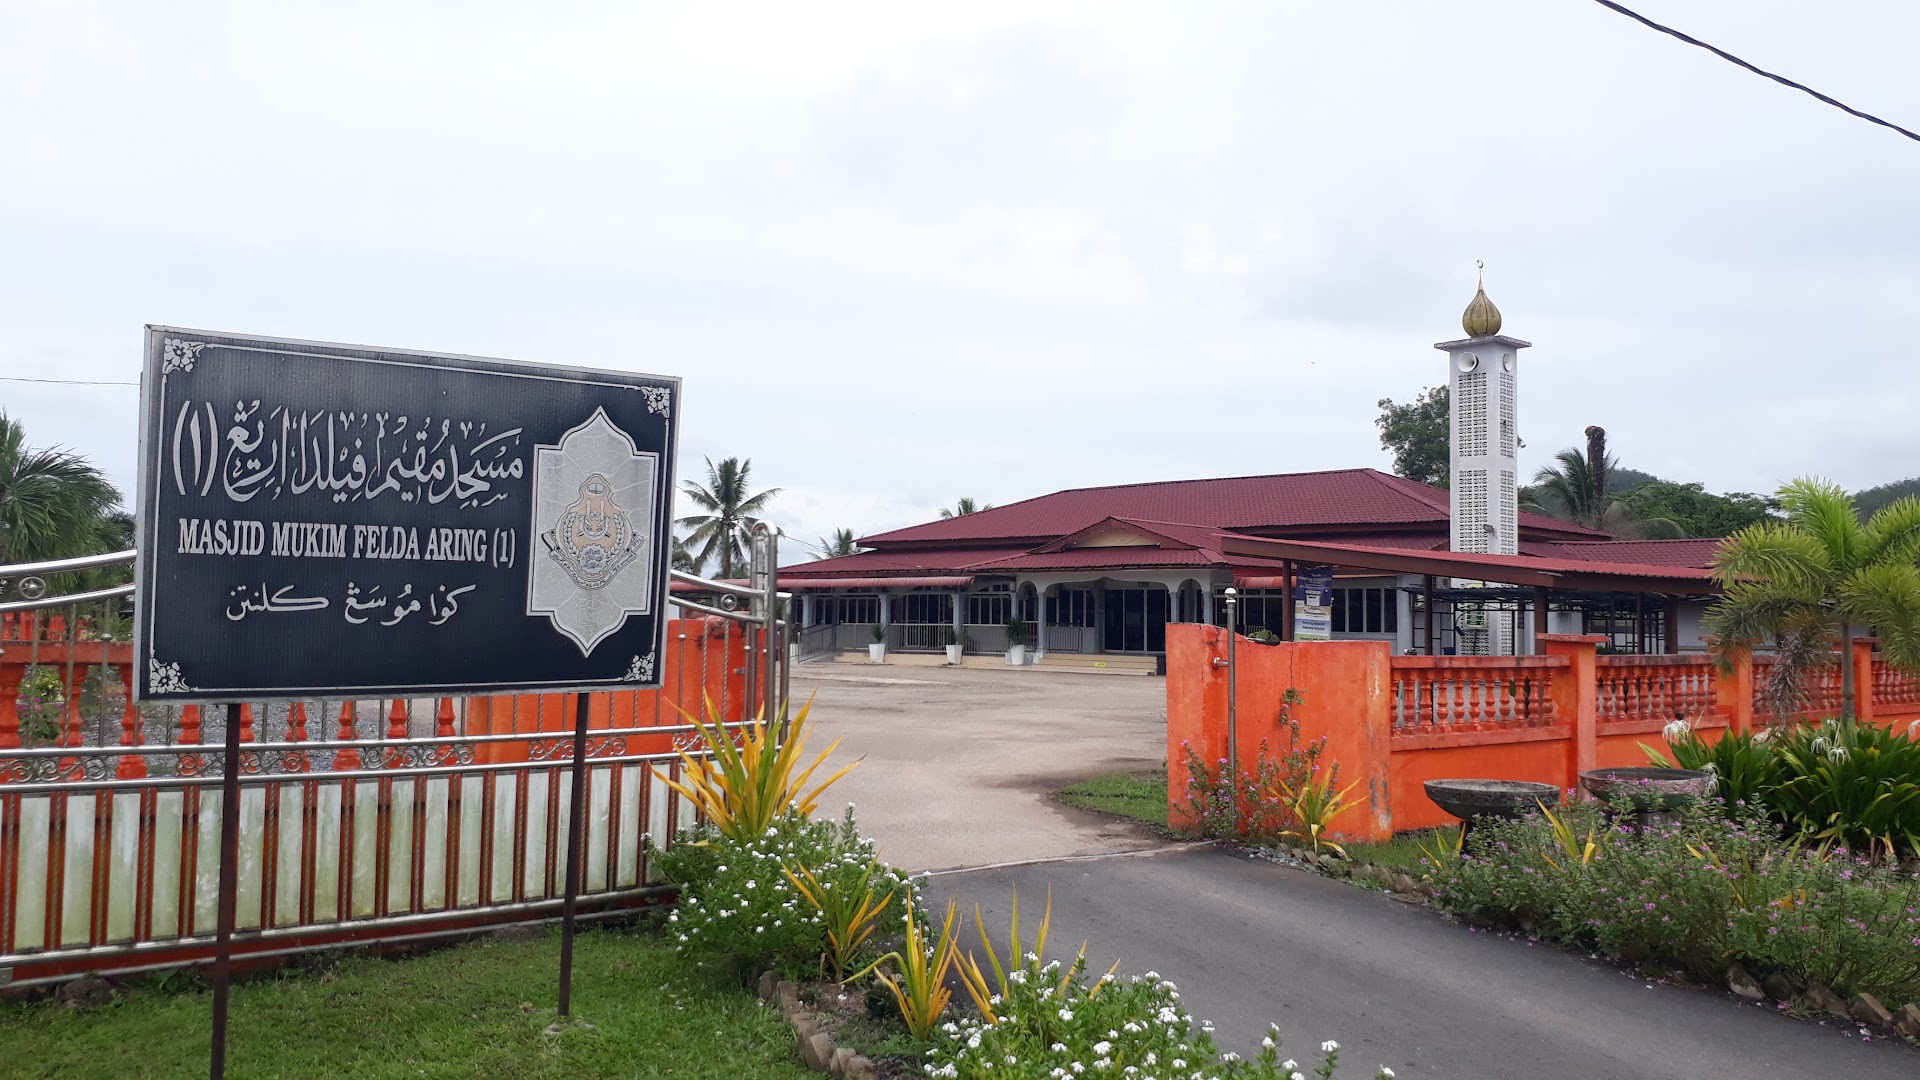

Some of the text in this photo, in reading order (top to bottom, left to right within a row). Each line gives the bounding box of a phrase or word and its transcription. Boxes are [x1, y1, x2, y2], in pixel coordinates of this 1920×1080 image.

[428, 421, 524, 510] مسجد
[177, 518, 516, 569] MASJID MUKIM FELDA ARING (1)
